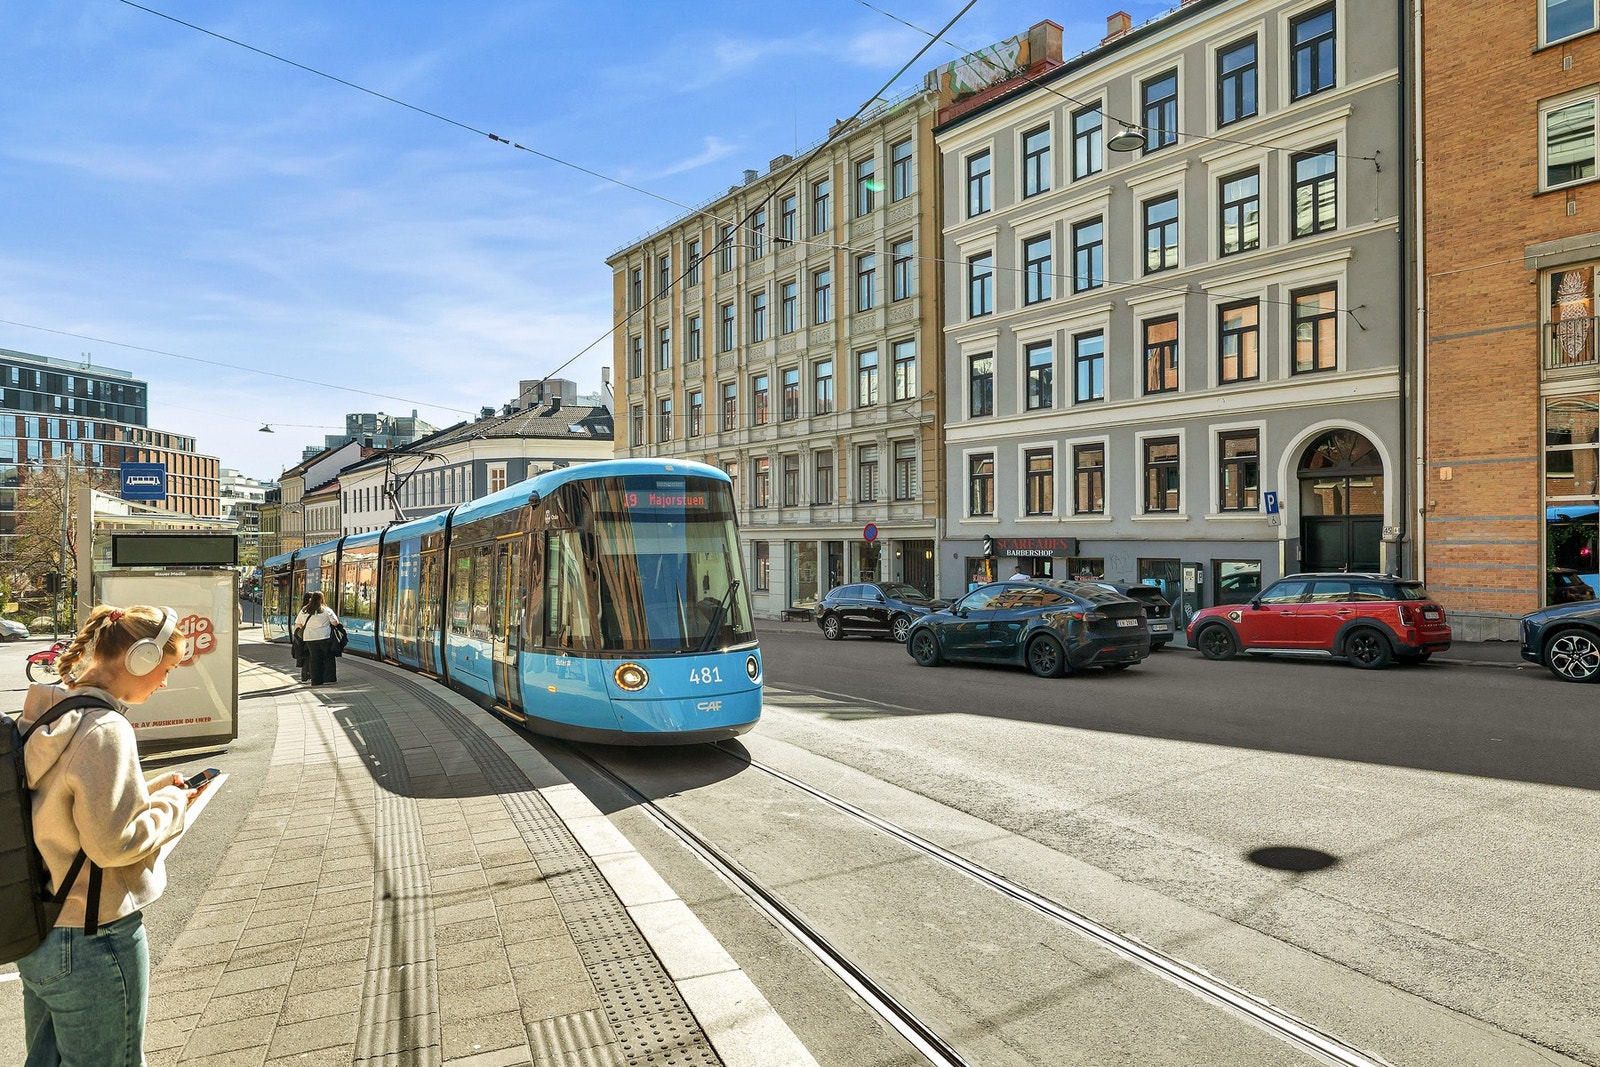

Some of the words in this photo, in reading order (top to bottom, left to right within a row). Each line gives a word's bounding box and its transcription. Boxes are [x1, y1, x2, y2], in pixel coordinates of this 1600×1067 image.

[623, 493, 638, 507] 19
[649, 493, 705, 508] Majorstuen
[1006, 549, 1054, 557] BARBERSHOP
[178, 616, 208, 636] dio
[183, 632, 212, 662] ge
[689, 666, 723, 684] 481
[697, 700, 722, 712] CAF
[152, 718, 184, 727] MUSIKKEN
